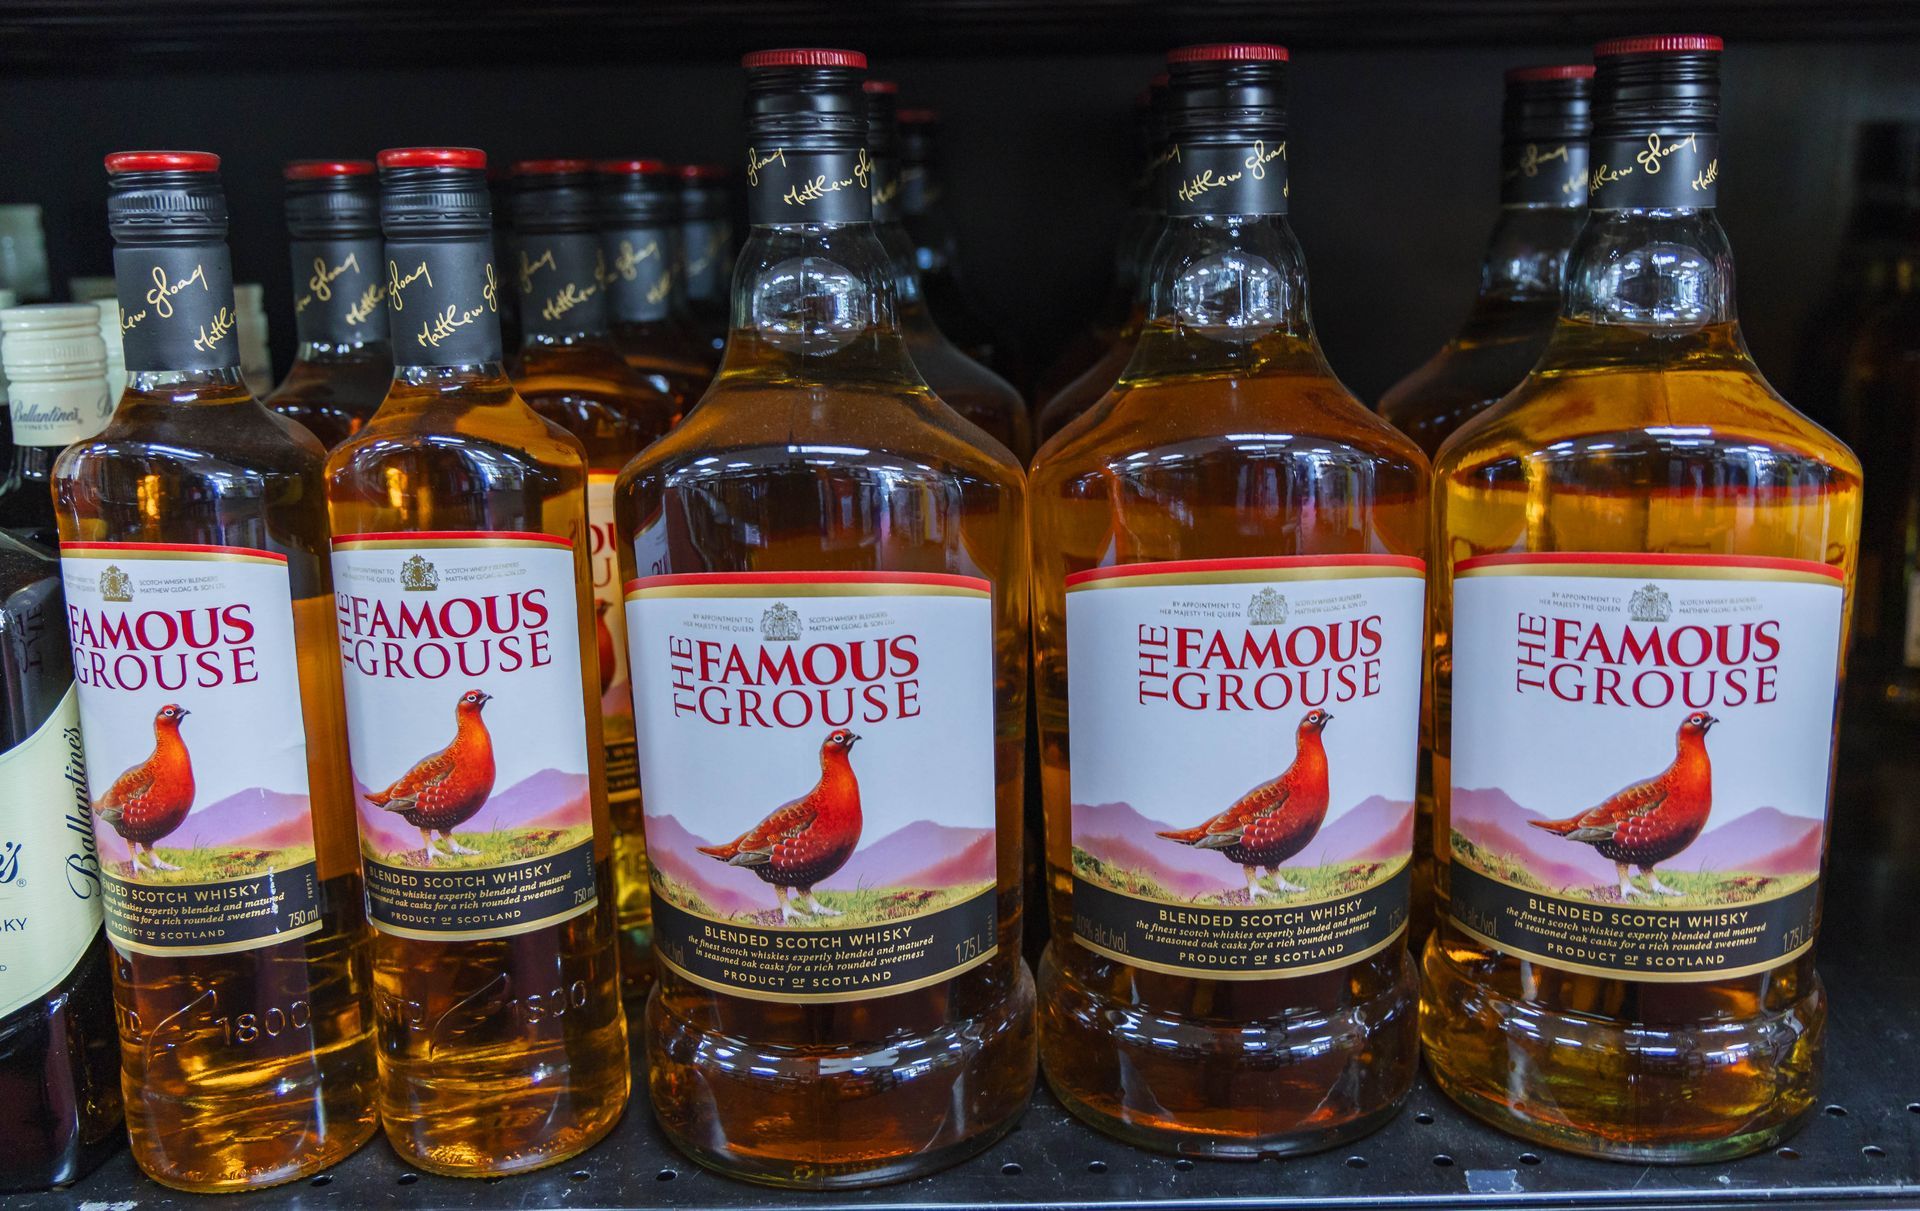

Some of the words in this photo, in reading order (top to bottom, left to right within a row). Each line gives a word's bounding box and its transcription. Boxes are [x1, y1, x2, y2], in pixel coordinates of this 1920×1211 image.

[1589, 164, 1632, 196] atthew
[1182, 601, 1230, 609] APPOINTMENT
[1562, 593, 1611, 603] APPOINTMENT
[69, 603, 255, 651] FAMOUS
[351, 588, 549, 640] FAMOUS
[1216, 610, 1241, 618] QUEEN
[355, 630, 552, 679] GROUSE
[1173, 615, 1382, 670] FAMOUS
[1516, 612, 1546, 693] THE
[1550, 617, 1780, 667] FAMOUS
[74, 646, 259, 691] GROUSE
[695, 634, 919, 686] FAMOUS
[1138, 624, 1169, 705] THE
[669, 635, 697, 718] THE
[1172, 658, 1381, 712] GROUSE
[1548, 664, 1778, 709] GROUSE
[698, 679, 921, 728] GROUSE
[103, 878, 128, 897] ENDED
[132, 889, 187, 903] SCOTCH
[195, 884, 260, 902] WHISKY
[369, 866, 418, 887] BLENDED
[424, 876, 486, 889] SCOTCH
[493, 863, 552, 884] WHISKY
[403, 889, 436, 901] whiskies
[439, 891, 476, 902] expertly
[480, 886, 517, 898] blended
[520, 881, 536, 892] and
[539, 870, 572, 888] matured
[181, 904, 222, 915] blended
[223, 901, 242, 911] and
[410, 899, 432, 910] casks
[434, 900, 448, 912] for
[460, 900, 479, 910] rich
[482, 895, 520, 907] rounded
[523, 884, 565, 901] sweetness
[1159, 910, 1233, 927] BLENDED
[1240, 912, 1304, 927] SCOTCH
[1310, 899, 1362, 921] WHISKY
[141, 913, 152, 925] for
[163, 915, 180, 925] rich
[184, 913, 224, 924] rounded
[288, 910, 306, 928] 750
[307, 905, 319, 921] ml
[391, 911, 436, 924] PRODUCT
[457, 910, 522, 924] SCOTLAND
[1136, 919, 1149, 931] the
[1151, 921, 1176, 936] finest
[1179, 928, 1209, 938] scotch
[1212, 928, 1253, 940] whiskies
[1256, 929, 1294, 940] expertly
[1296, 923, 1331, 936] blended
[1332, 919, 1348, 931] and
[1349, 907, 1377, 927] matured
[1505, 905, 1519, 917] the
[1520, 909, 1546, 927] finest
[1547, 918, 1579, 931] scotch
[1581, 925, 1624, 938] whiskies
[1627, 930, 1669, 942] expertly
[1671, 928, 1710, 940] blended
[1712, 927, 1729, 939] and
[1731, 922, 1766, 937] matured
[1529, 898, 1603, 922] BLENDED
[1611, 913, 1680, 929] SCOTCH
[1687, 911, 1749, 928] WHISKY
[160, 928, 226, 940] SCOTLAND
[688, 934, 699, 945] the
[698, 939, 720, 955] finest
[722, 946, 749, 958] scotch
[750, 949, 789, 961] whiskies
[792, 952, 832, 963] expertly
[835, 948, 875, 961] blended
[876, 944, 895, 956] and
[896, 935, 934, 953] matured
[704, 925, 769, 947] BLENDED
[775, 936, 842, 949] SCOTCH
[849, 926, 912, 947] WHISKY
[1145, 931, 1154, 941] in
[1155, 935, 1199, 948] seasoned
[1201, 939, 1219, 949] oak
[1221, 940, 1247, 950] casks
[1249, 940, 1264, 951] for
[1275, 936, 1295, 948] rich
[1297, 932, 1333, 946] rounded
[1335, 921, 1370, 941] sweetness
[1514, 919, 1523, 929] in
[1525, 922, 1567, 939] seasoned
[1569, 931, 1587, 943] oak
[1590, 937, 1617, 948] casks
[1619, 938, 1636, 950] for
[1649, 939, 1670, 951] rich
[1672, 939, 1712, 950] rounded
[1714, 935, 1757, 949] sweetness
[695, 948, 703, 957] in
[703, 952, 740, 966] seasoned
[741, 957, 758, 969] oak
[759, 960, 784, 971] casks
[786, 962, 802, 974] for
[814, 960, 834, 971] rich
[836, 958, 877, 970] rounded
[879, 949, 925, 966] sweetness
[955, 936, 976, 963] 1.75
[1179, 951, 1246, 965] PRODUCT
[1254, 954, 1268, 965] OF
[1274, 944, 1344, 964] SCOTLAND
[1547, 942, 1616, 963] PRODUCT
[1624, 954, 1639, 966] OF
[1646, 954, 1725, 966] SCOTLAND
[723, 970, 785, 987] PRODUCT
[792, 978, 805, 988] OF
[812, 971, 892, 987] SCOTLAND
